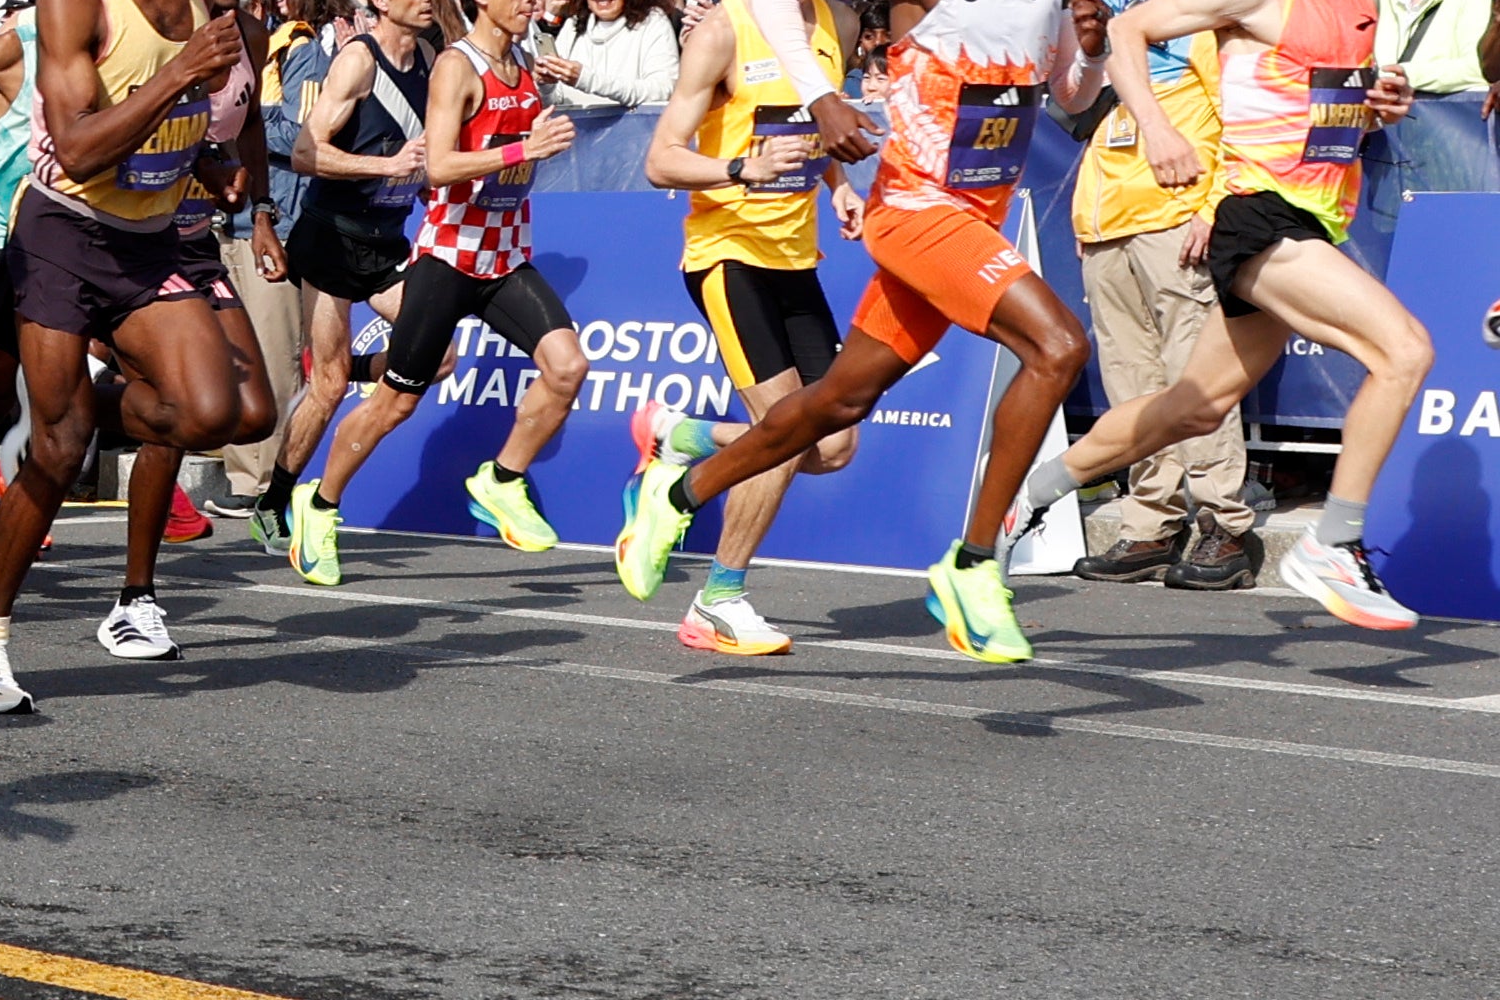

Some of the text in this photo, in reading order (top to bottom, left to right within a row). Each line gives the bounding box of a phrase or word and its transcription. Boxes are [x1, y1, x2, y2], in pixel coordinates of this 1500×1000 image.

[976, 249, 1023, 284] INE
[574, 321, 722, 364] OSTO
[437, 367, 732, 417] MATHON
[871, 409, 952, 428] AMERICA
